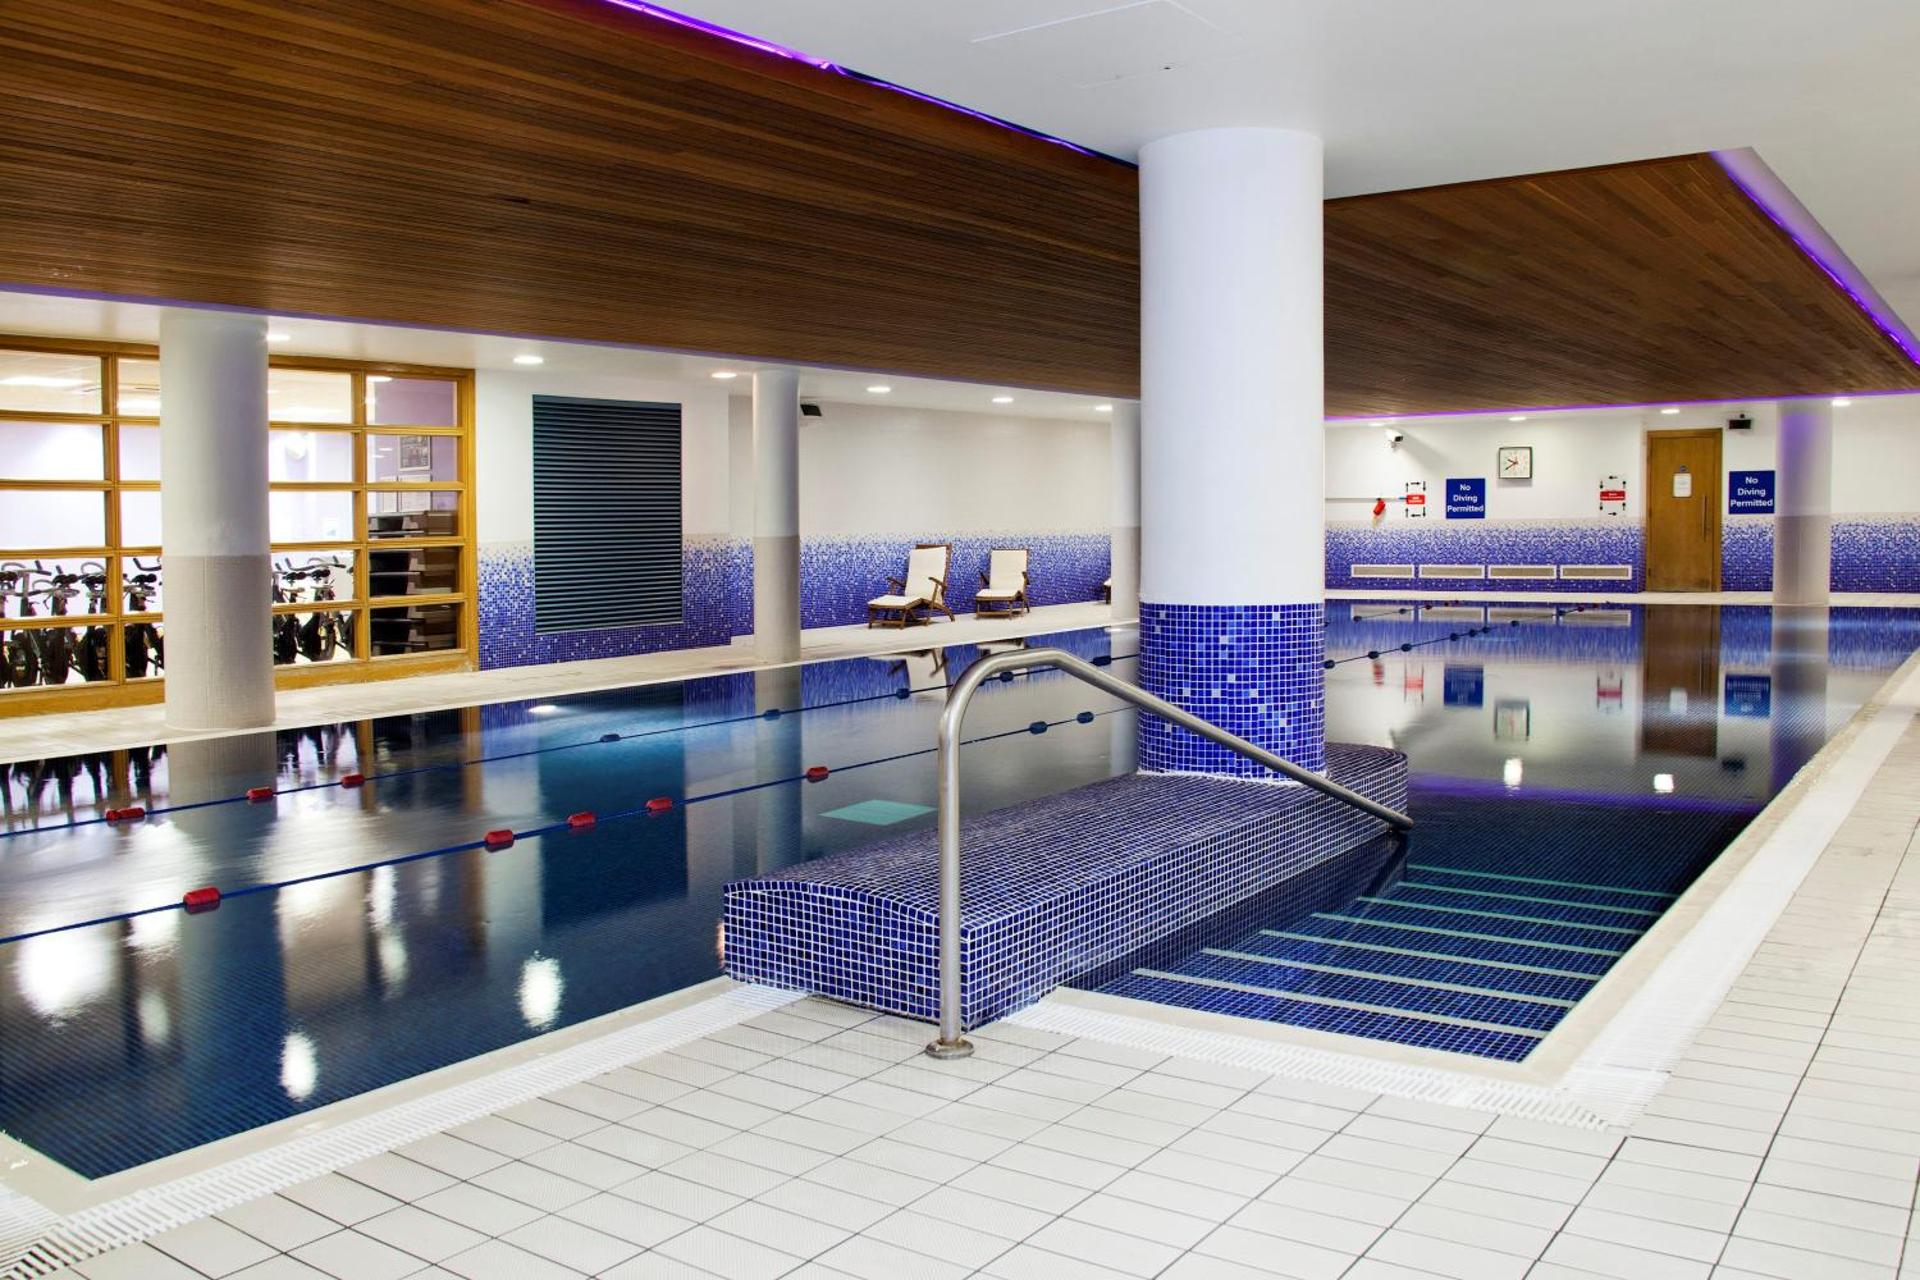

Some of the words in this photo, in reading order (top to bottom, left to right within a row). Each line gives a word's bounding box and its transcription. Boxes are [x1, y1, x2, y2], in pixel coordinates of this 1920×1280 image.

[1745, 476, 1759, 484] No
[1737, 487, 1766, 497] Diving
[1453, 494, 1478, 503] Diving
[1730, 499, 1773, 508] Permitted
[1447, 505, 1484, 513] Permitted
